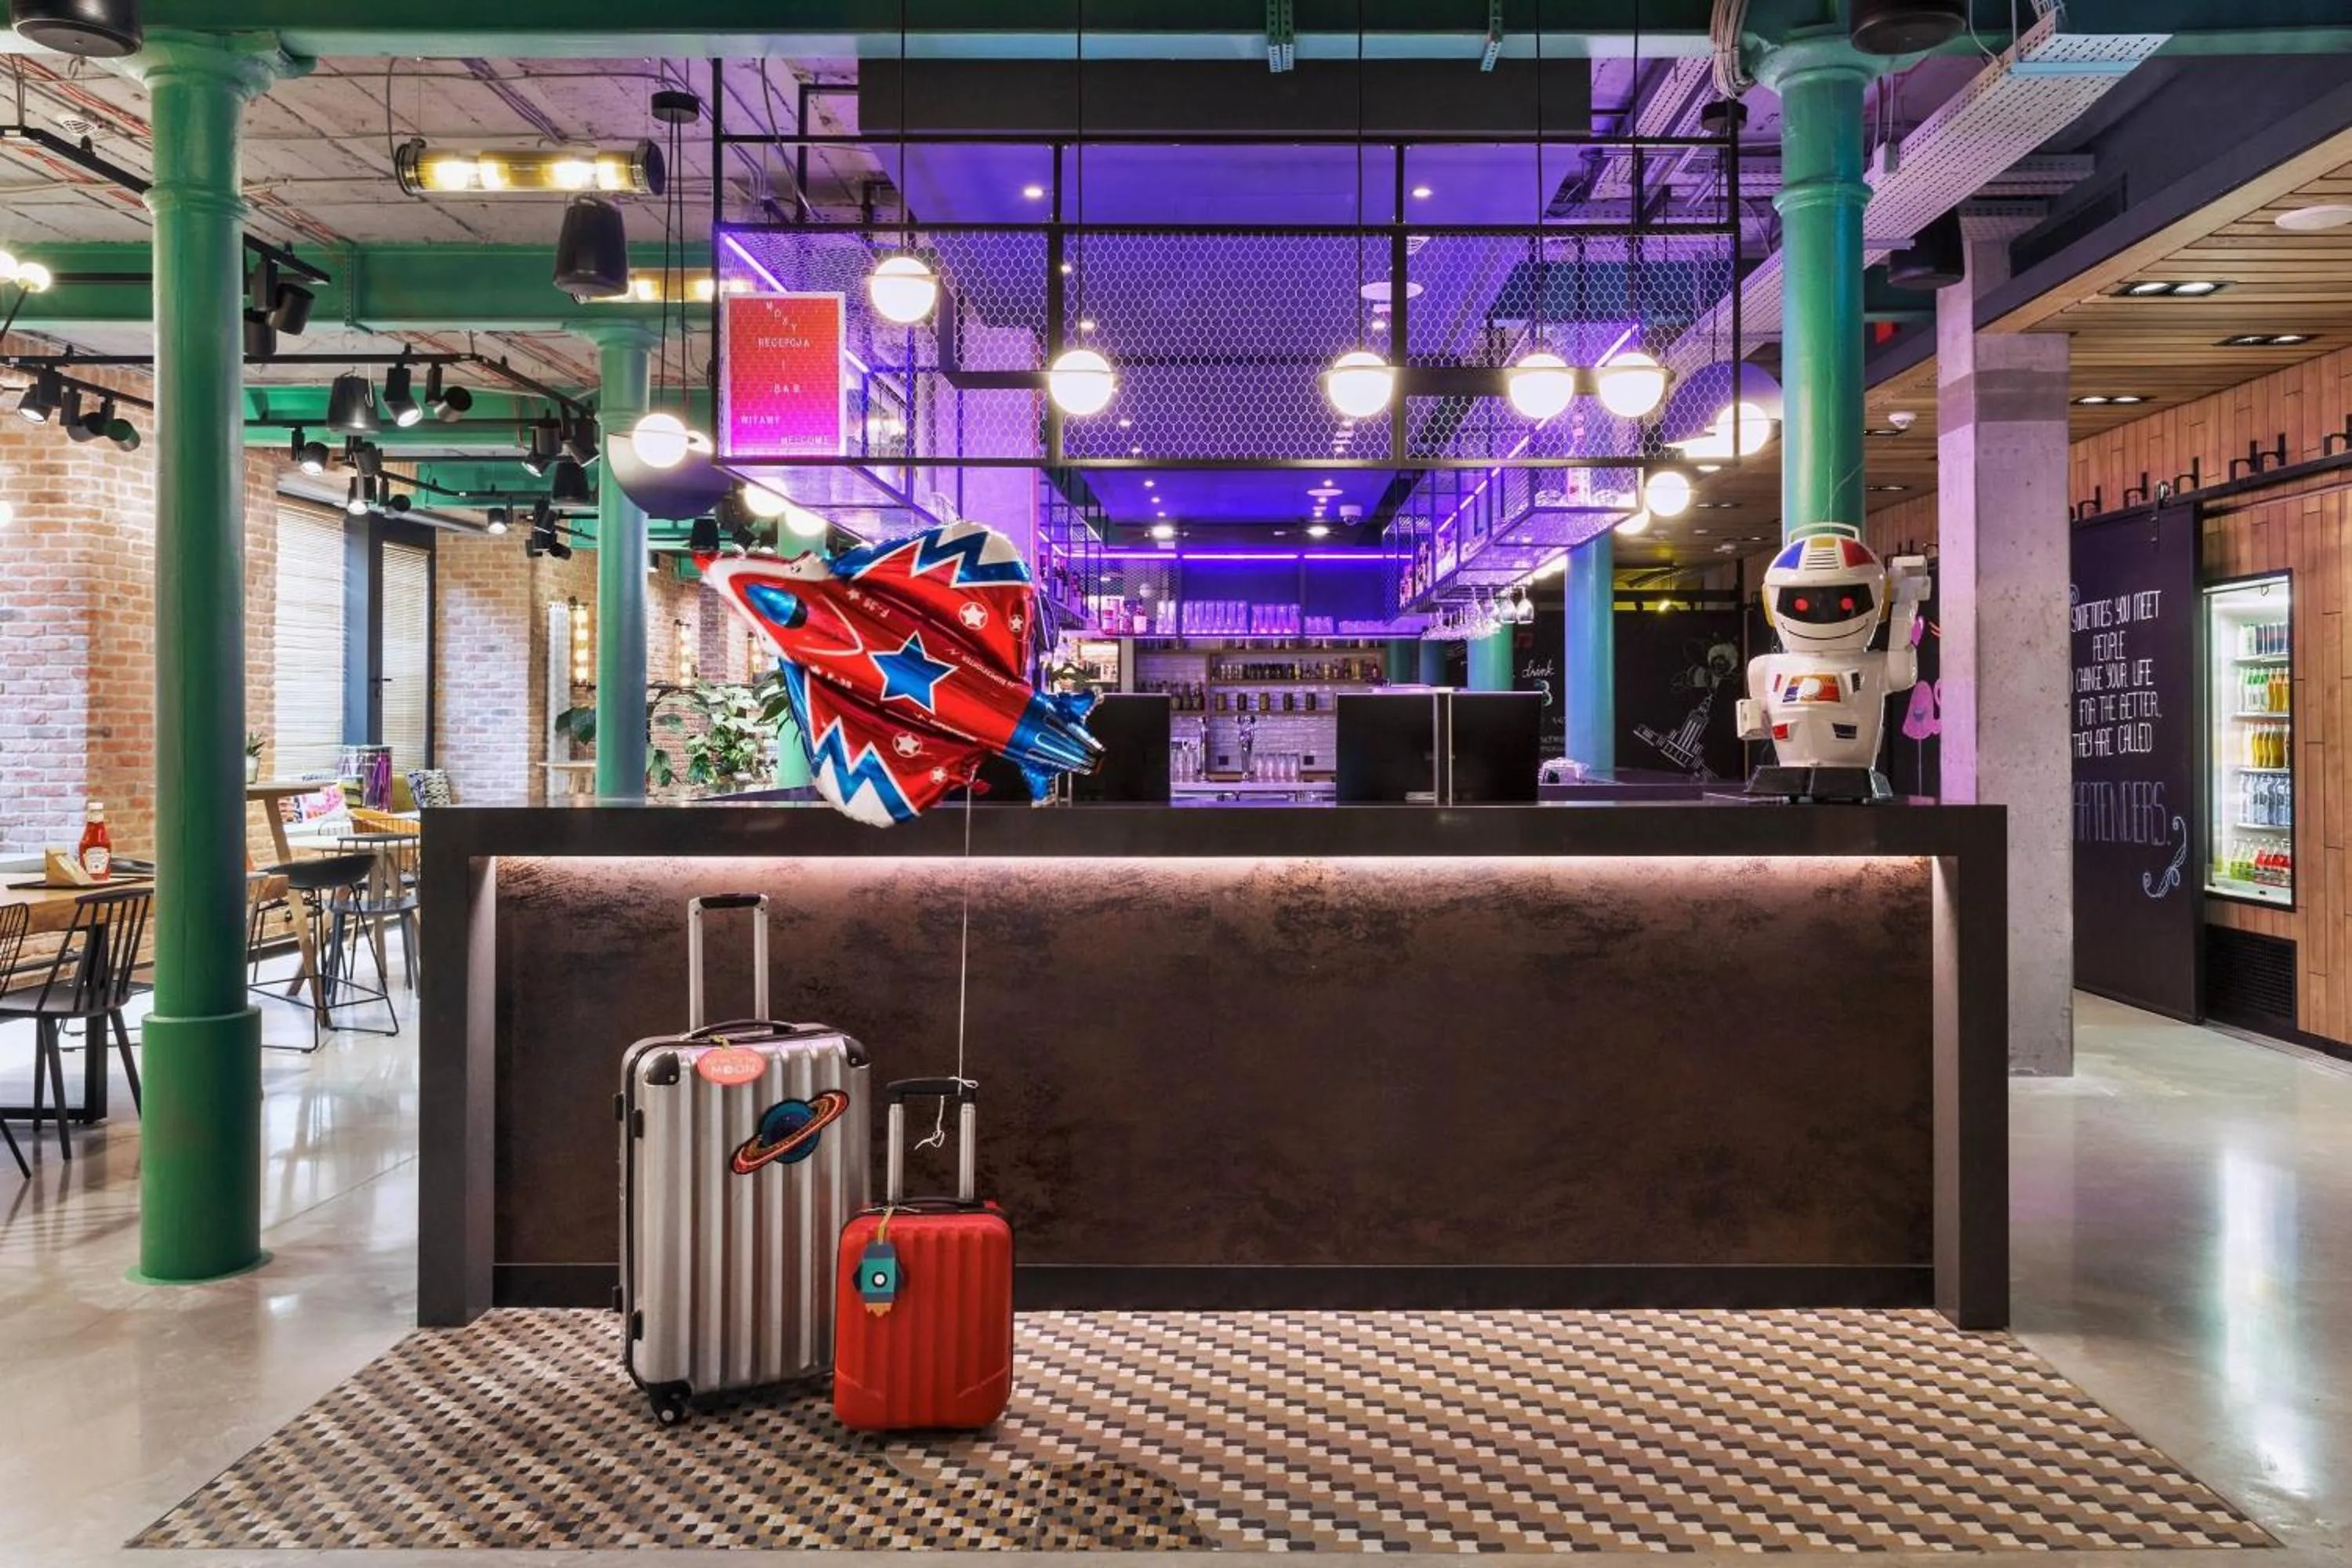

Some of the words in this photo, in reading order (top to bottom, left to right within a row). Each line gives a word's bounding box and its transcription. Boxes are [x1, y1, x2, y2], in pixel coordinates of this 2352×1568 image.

[774, 383, 800, 394] BAR
[2070, 599, 2112, 632] SOMETIMES
[2115, 594, 2130, 625] YOU
[2133, 590, 2161, 622] MEET
[2092, 630, 2126, 661] PEOPLE
[2076, 666, 2103, 691] CHANGE
[2105, 662, 2128, 689] YOUR
[2133, 659, 2154, 686] LIFE
[2080, 698, 2096, 727] FOR
[2099, 695, 2117, 723] THE
[2072, 731, 2092, 758] THEY
[2095, 728, 2114, 757] ARE
[2118, 723, 2152, 754] CALLED
[2073, 781, 2171, 846] ARTENDERS.
